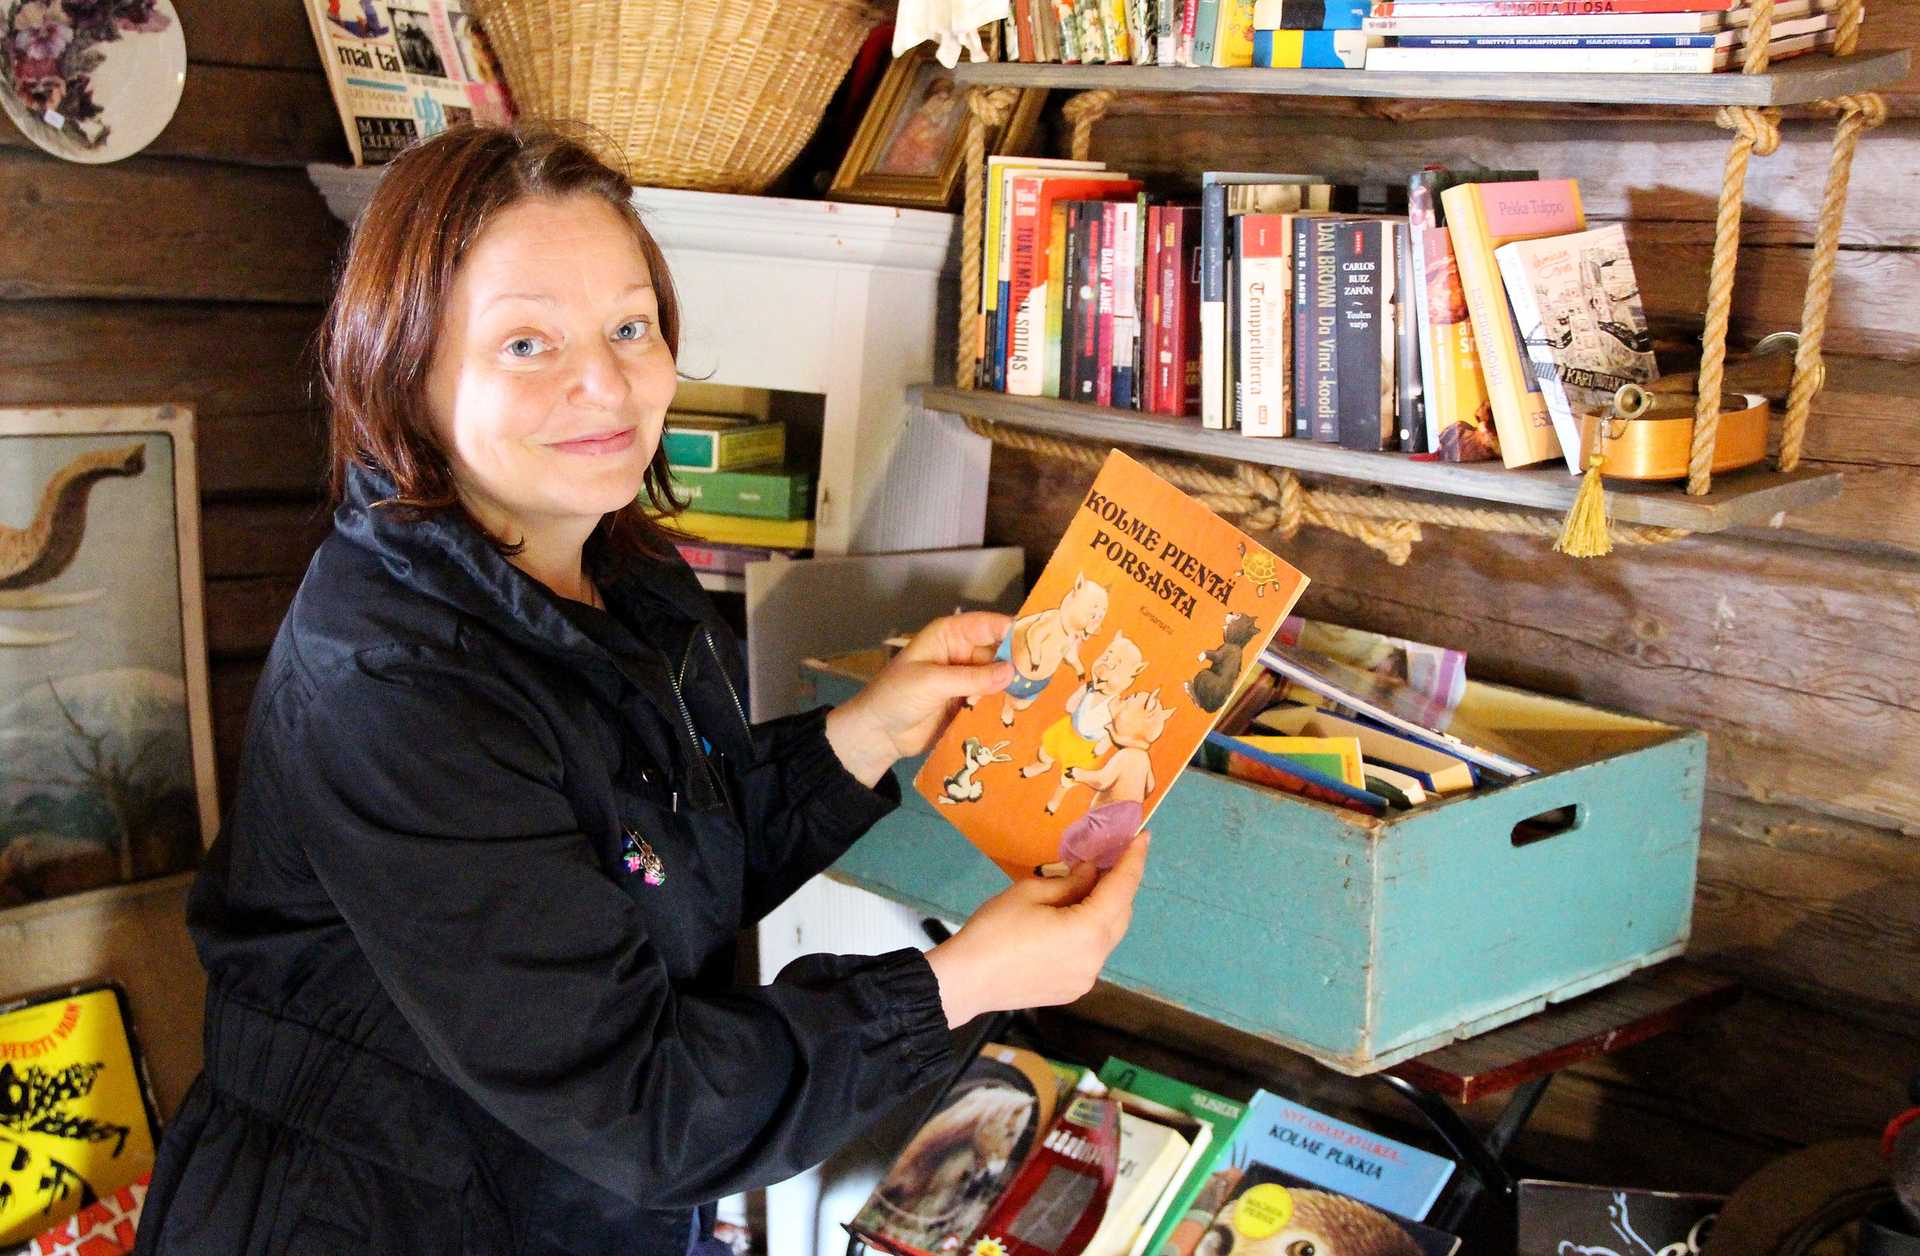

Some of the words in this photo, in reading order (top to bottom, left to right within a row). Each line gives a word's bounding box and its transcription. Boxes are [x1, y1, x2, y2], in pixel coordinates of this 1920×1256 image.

[1583, 1, 1614, 13] OSA
[337, 43, 374, 69] mai
[376, 46, 401, 73] tai
[1317, 222, 1336, 253] DAN
[1016, 227, 1033, 315] TUNTEMATON
[1100, 247, 1114, 281] BABY
[1342, 261, 1375, 271] CARLOS
[1348, 274, 1370, 283] RUIZ
[1099, 282, 1113, 315] JANE
[1317, 255, 1336, 308] BROWN
[1343, 285, 1374, 296] ZAFÓN
[1318, 316, 1336, 335] Da
[1012, 318, 1030, 373] SOTILAS
[1318, 338, 1337, 372] Vinci
[1318, 375, 1338, 419] -koodi
[1084, 489, 1162, 552] KOLME
[1159, 541, 1238, 607] PIENTÄ
[1090, 529, 1198, 620] PORSASTA
[1268, 1122, 1323, 1157] KOLME
